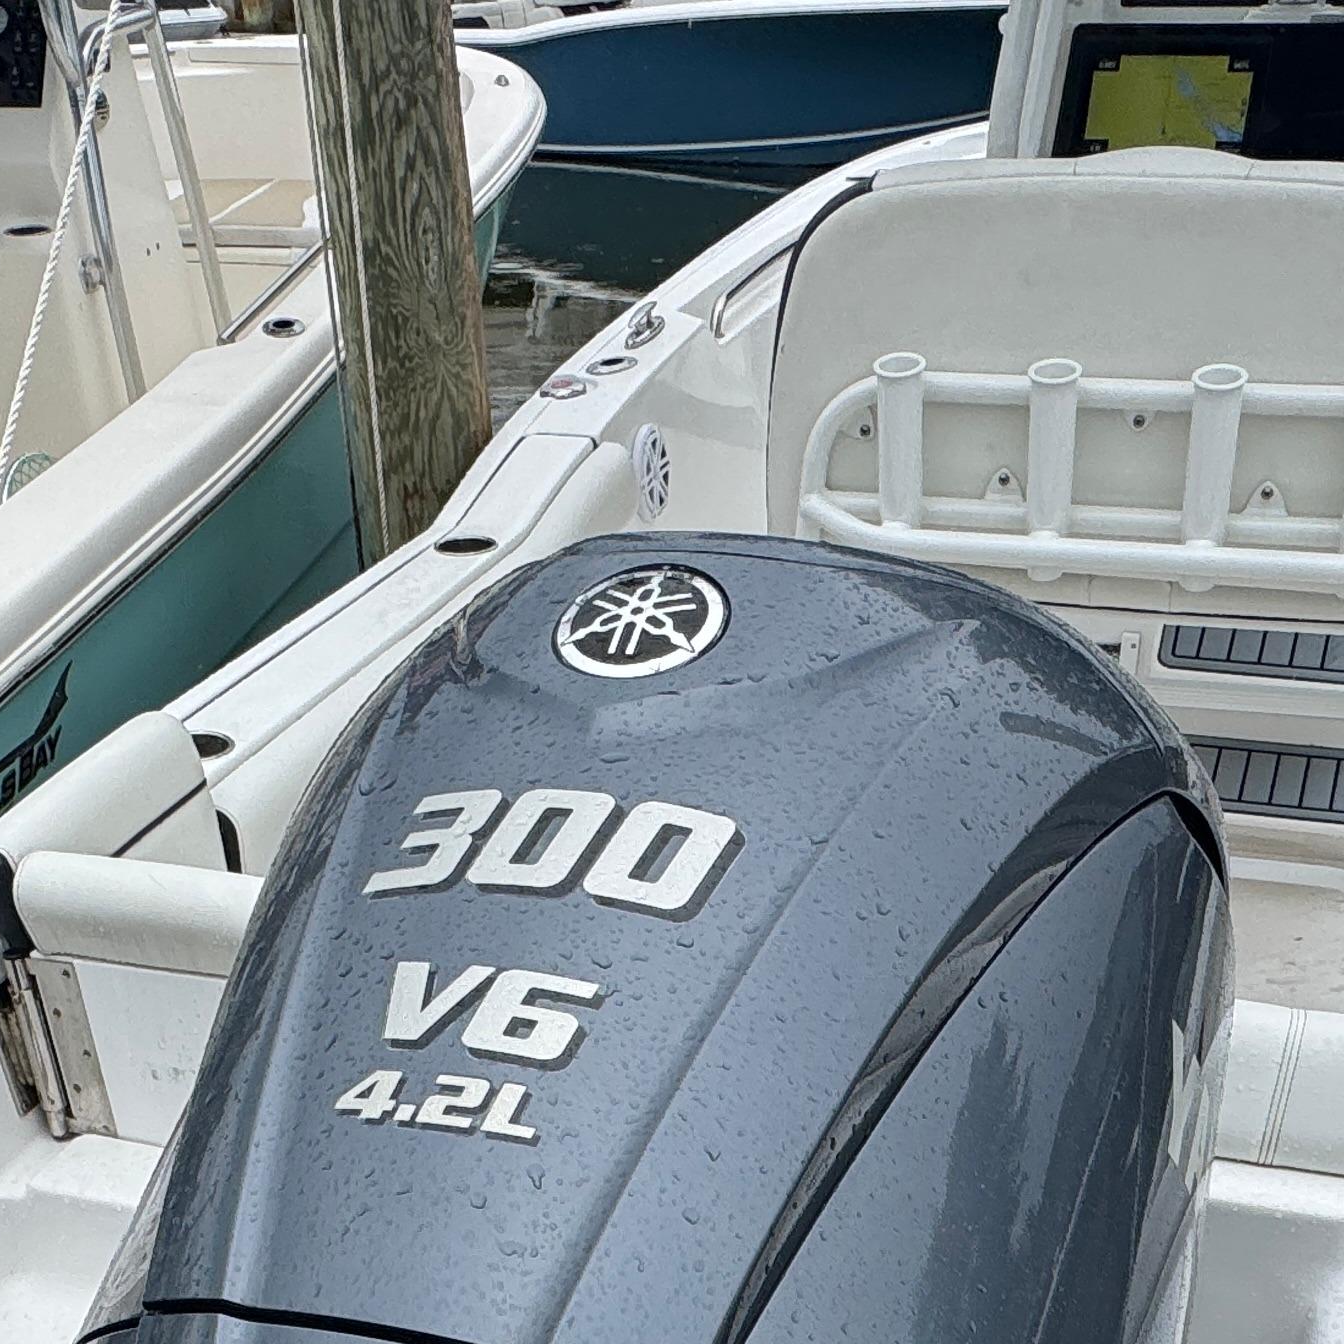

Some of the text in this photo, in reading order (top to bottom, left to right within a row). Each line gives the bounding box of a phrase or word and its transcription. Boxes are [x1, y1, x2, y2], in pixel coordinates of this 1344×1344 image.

[361, 788, 744, 920] 300
[381, 960, 602, 1066] V6
[333, 1069, 538, 1142] 4.2L
